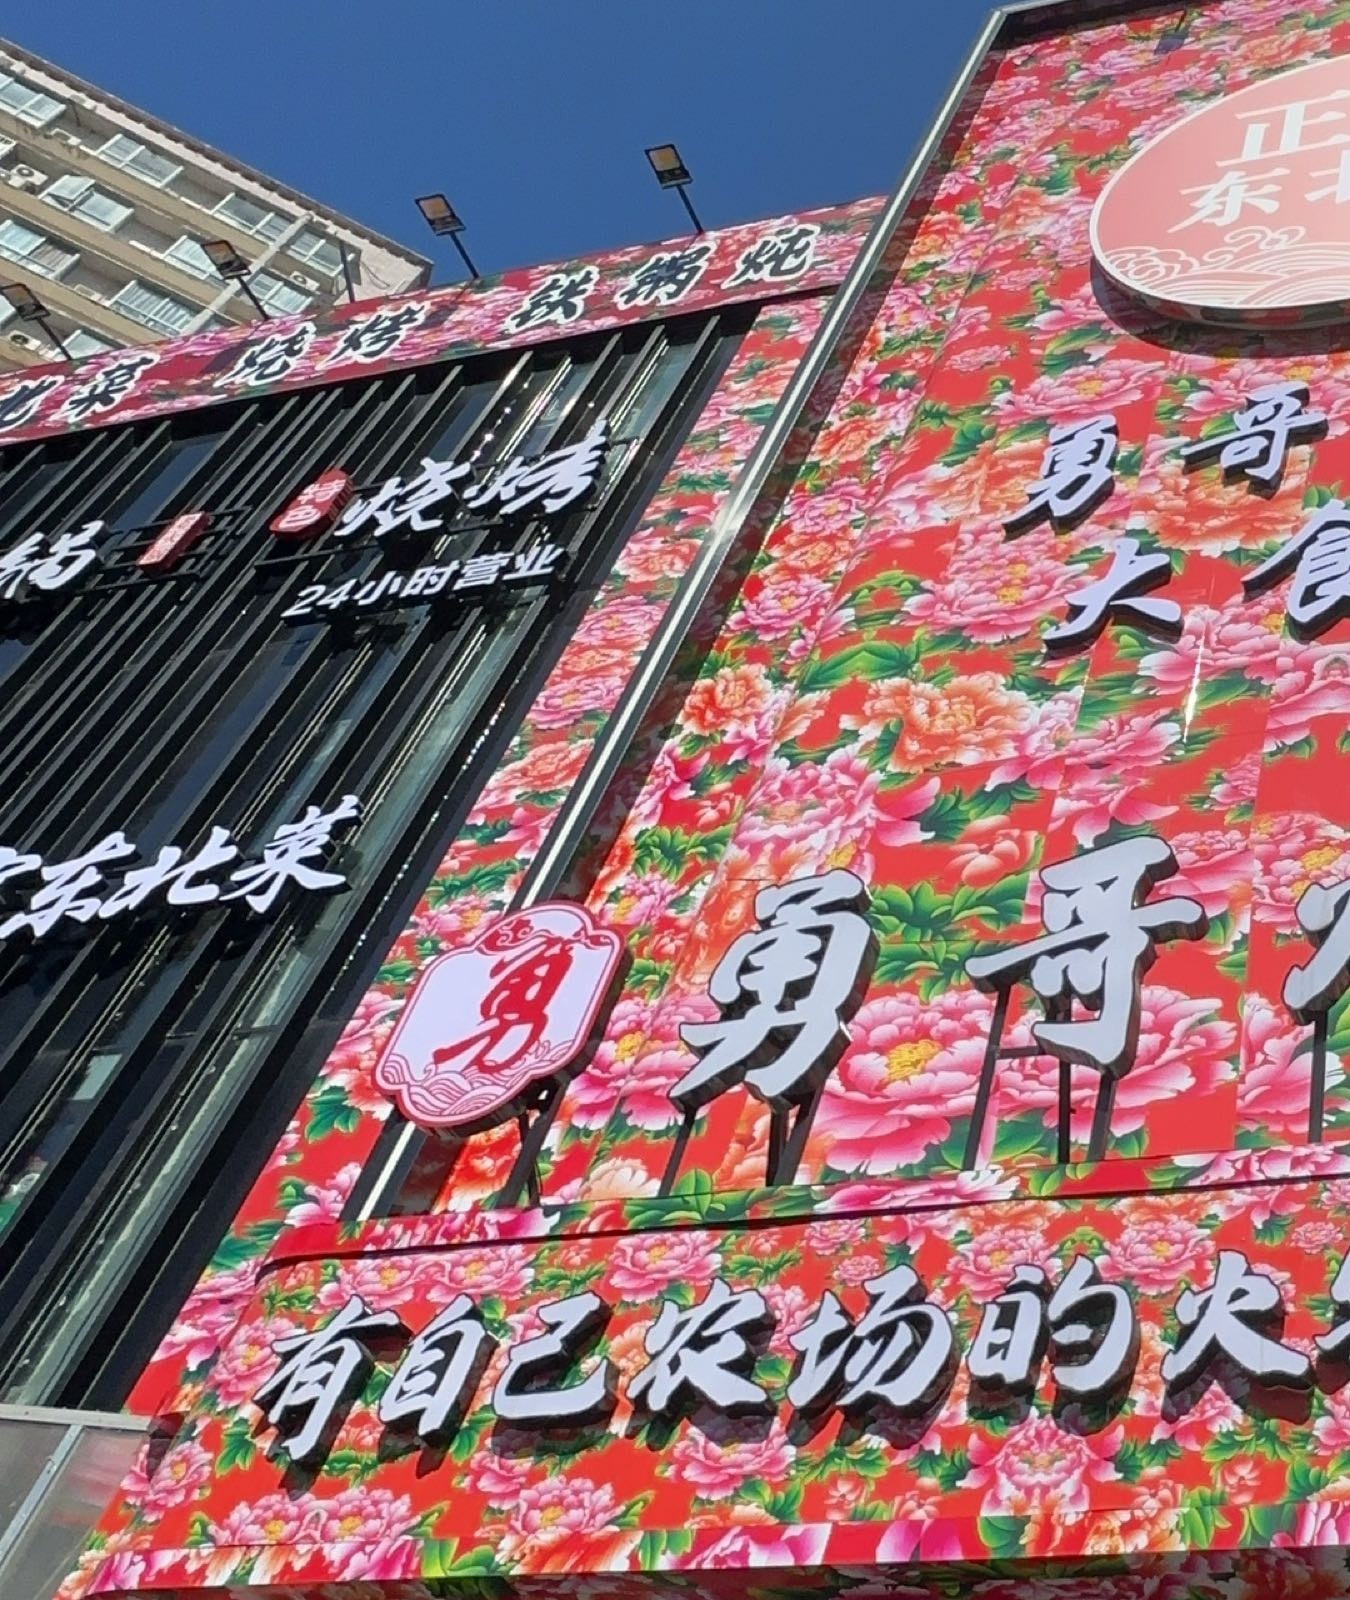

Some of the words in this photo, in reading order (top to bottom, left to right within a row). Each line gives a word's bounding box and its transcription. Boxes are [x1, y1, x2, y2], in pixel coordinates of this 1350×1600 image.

[215, 302, 429, 384] 烧烤
[506, 225, 820, 331] 铁锅炖
[278, 479, 347, 530] 特色
[334, 419, 611, 537] 烧烤
[281, 543, 566, 619] 24小时营业
[433, 937, 575, 1071] 勇
